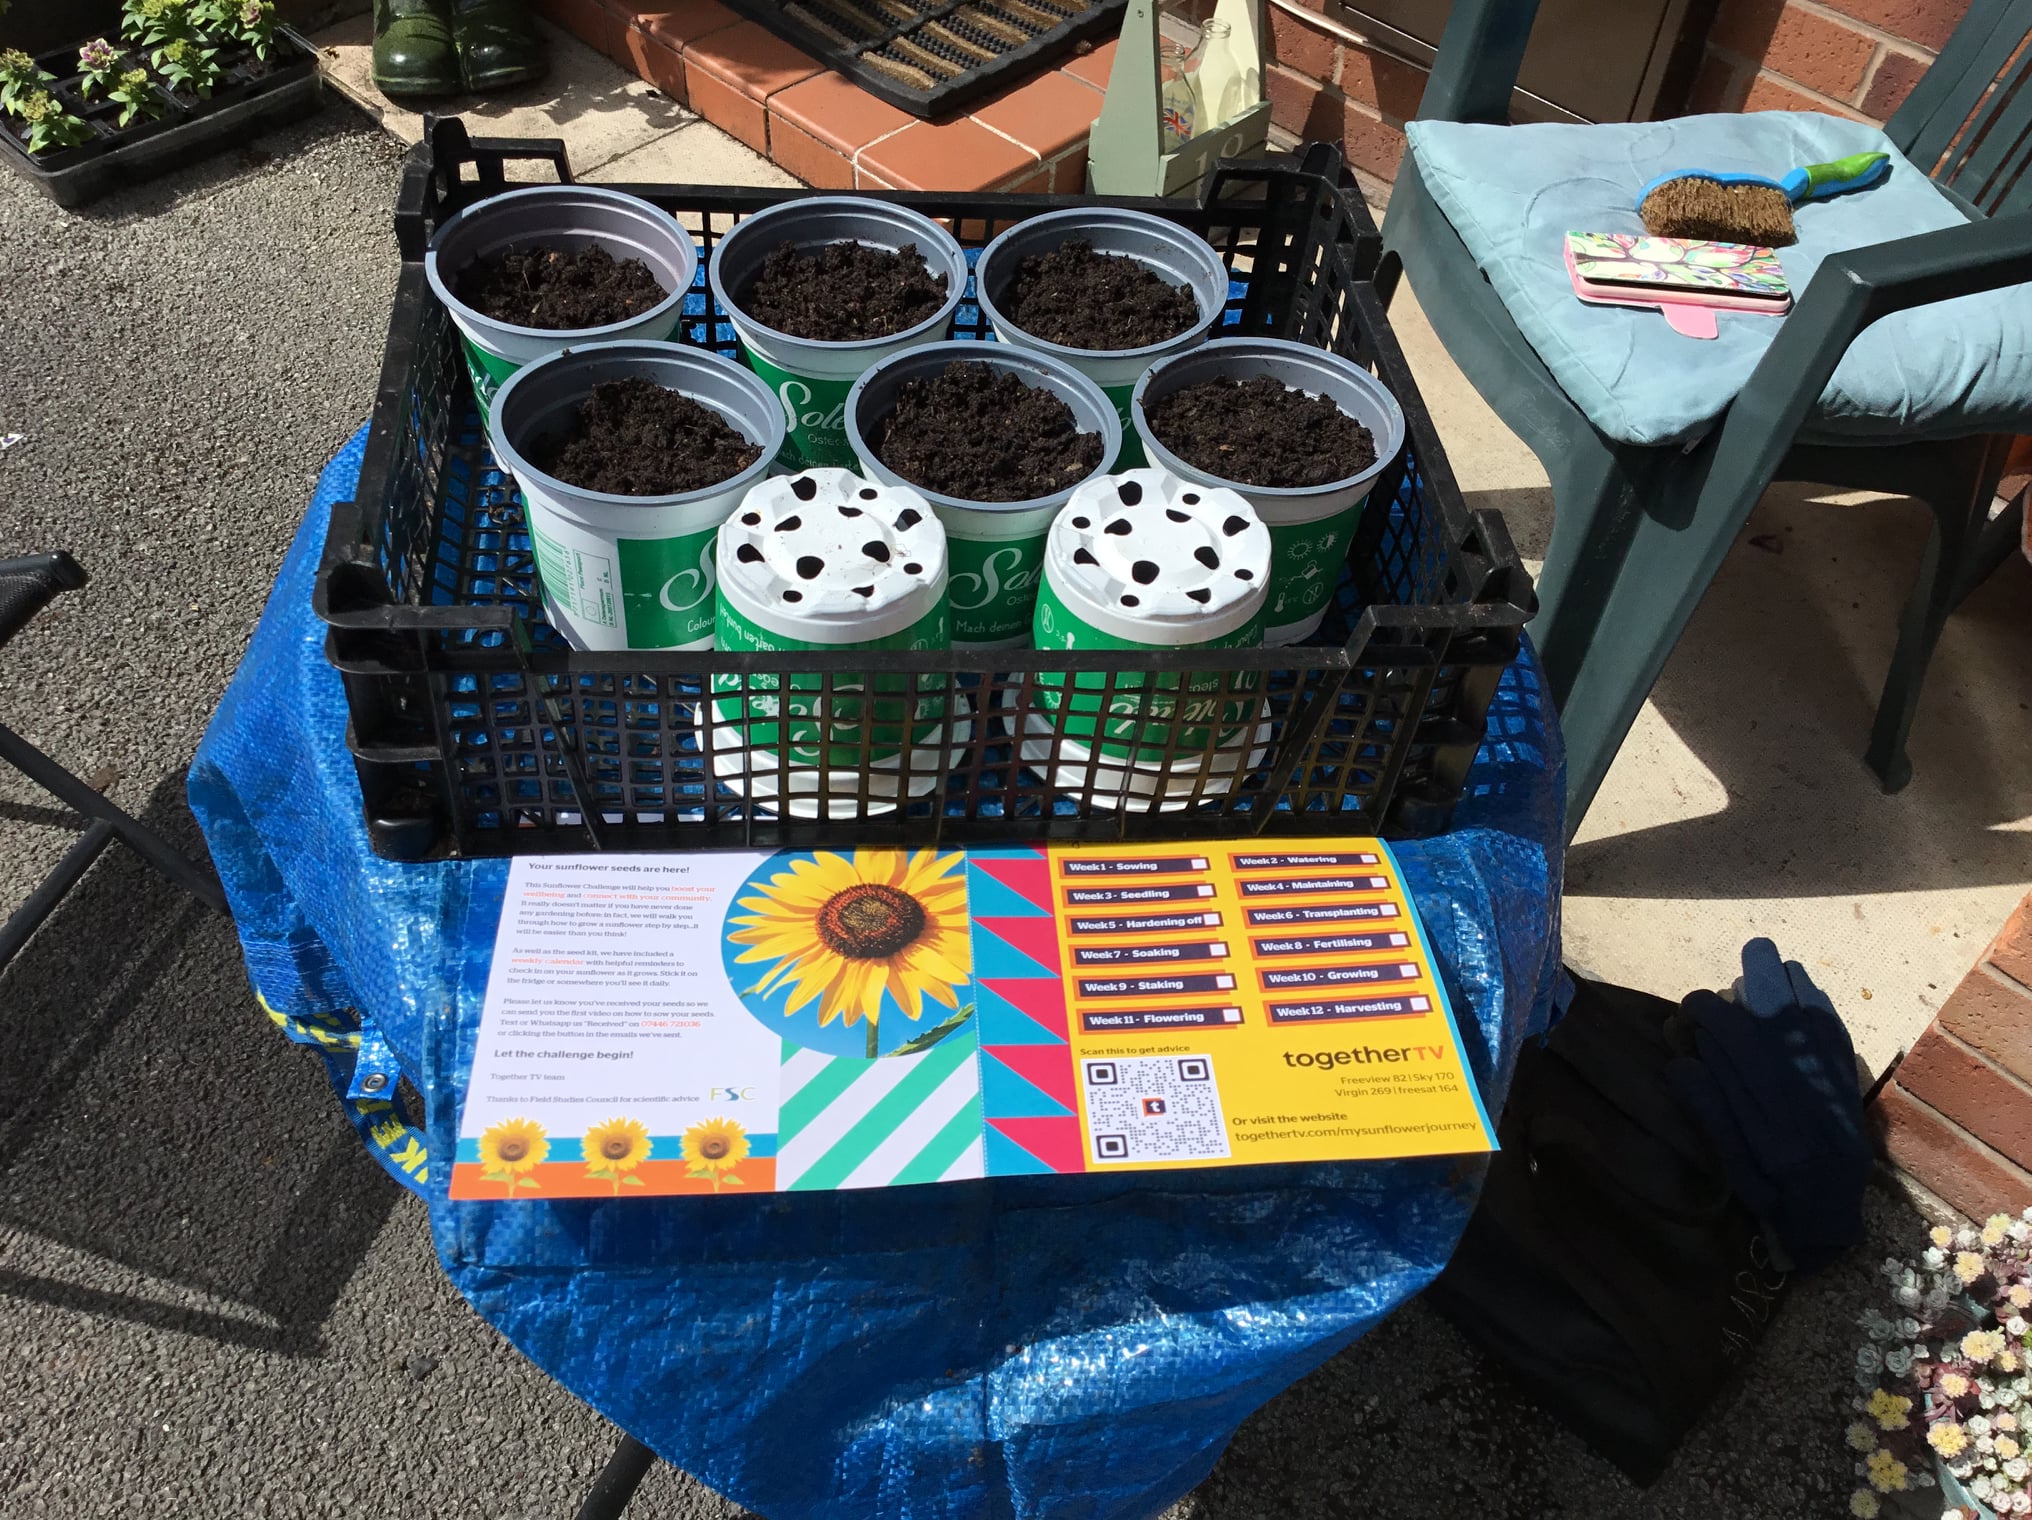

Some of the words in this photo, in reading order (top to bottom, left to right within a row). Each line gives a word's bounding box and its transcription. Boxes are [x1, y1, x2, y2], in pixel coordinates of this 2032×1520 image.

[955, 619, 987, 634] Mach
[662, 866, 690, 874] here!
[1069, 863, 1100, 871] Week
[1116, 862, 1158, 871] Sowing
[582, 883, 621, 891] Challenge
[1247, 883, 1277, 892] Week
[1291, 880, 1354, 889] Maintaining
[1073, 892, 1104, 900] Week
[1120, 890, 1170, 899] Seedling
[1254, 912, 1285, 921] Week
[1303, 906, 1379, 918] Transplanting
[1077, 921, 1109, 930] Week
[1126, 918, 1186, 928] Hardening
[1186, 916, 1203, 925] off
[1261, 942, 1294, 951] Week
[1313, 938, 1372, 949] Fertilising
[1080, 951, 1113, 959] Week
[1132, 948, 1180, 958] Soaking
[1268, 974, 1302, 983] Week
[1327, 970, 1379, 980] Growing
[1085, 983, 1118, 992] Week
[1138, 980, 1184, 990] Staking
[1276, 1007, 1310, 1017] Week
[1334, 1002, 1402, 1014] Harvesting
[1089, 1016, 1123, 1025] Week
[1144, 1013, 1205, 1023] Flowering
[494, 1049, 513, 1058] Let
[515, 1050, 535, 1058] the
[537, 1050, 595, 1061] challenge
[596, 1051, 634, 1061] begin!
[1080, 1048, 1105, 1056] Scan
[1139, 1046, 1155, 1055] get
[1157, 1045, 1190, 1053] advice
[1284, 1046, 1444, 1070] togetherTV
[491, 1073, 528, 1081] Together
[1340, 1076, 1391, 1085] Freeview
[1392, 1074, 1408, 1083] 82
[1413, 1073, 1433, 1082] Sky
[1435, 1072, 1455, 1081] 170
[710, 1086, 756, 1102] FSC
[1335, 1088, 1369, 1098] Virgin
[1370, 1087, 1392, 1096] 269
[1398, 1086, 1437, 1094] freesat
[1439, 1084, 1459, 1093] 164
[1150, 1101, 1161, 1112] t
[1232, 1117, 1246, 1126] Or
[1250, 1116, 1276, 1125] visit
[1277, 1115, 1298, 1124] the
[1300, 1112, 1348, 1122] website
[1235, 1122, 1476, 1143] togethertv.com/mysunflowerjourney
